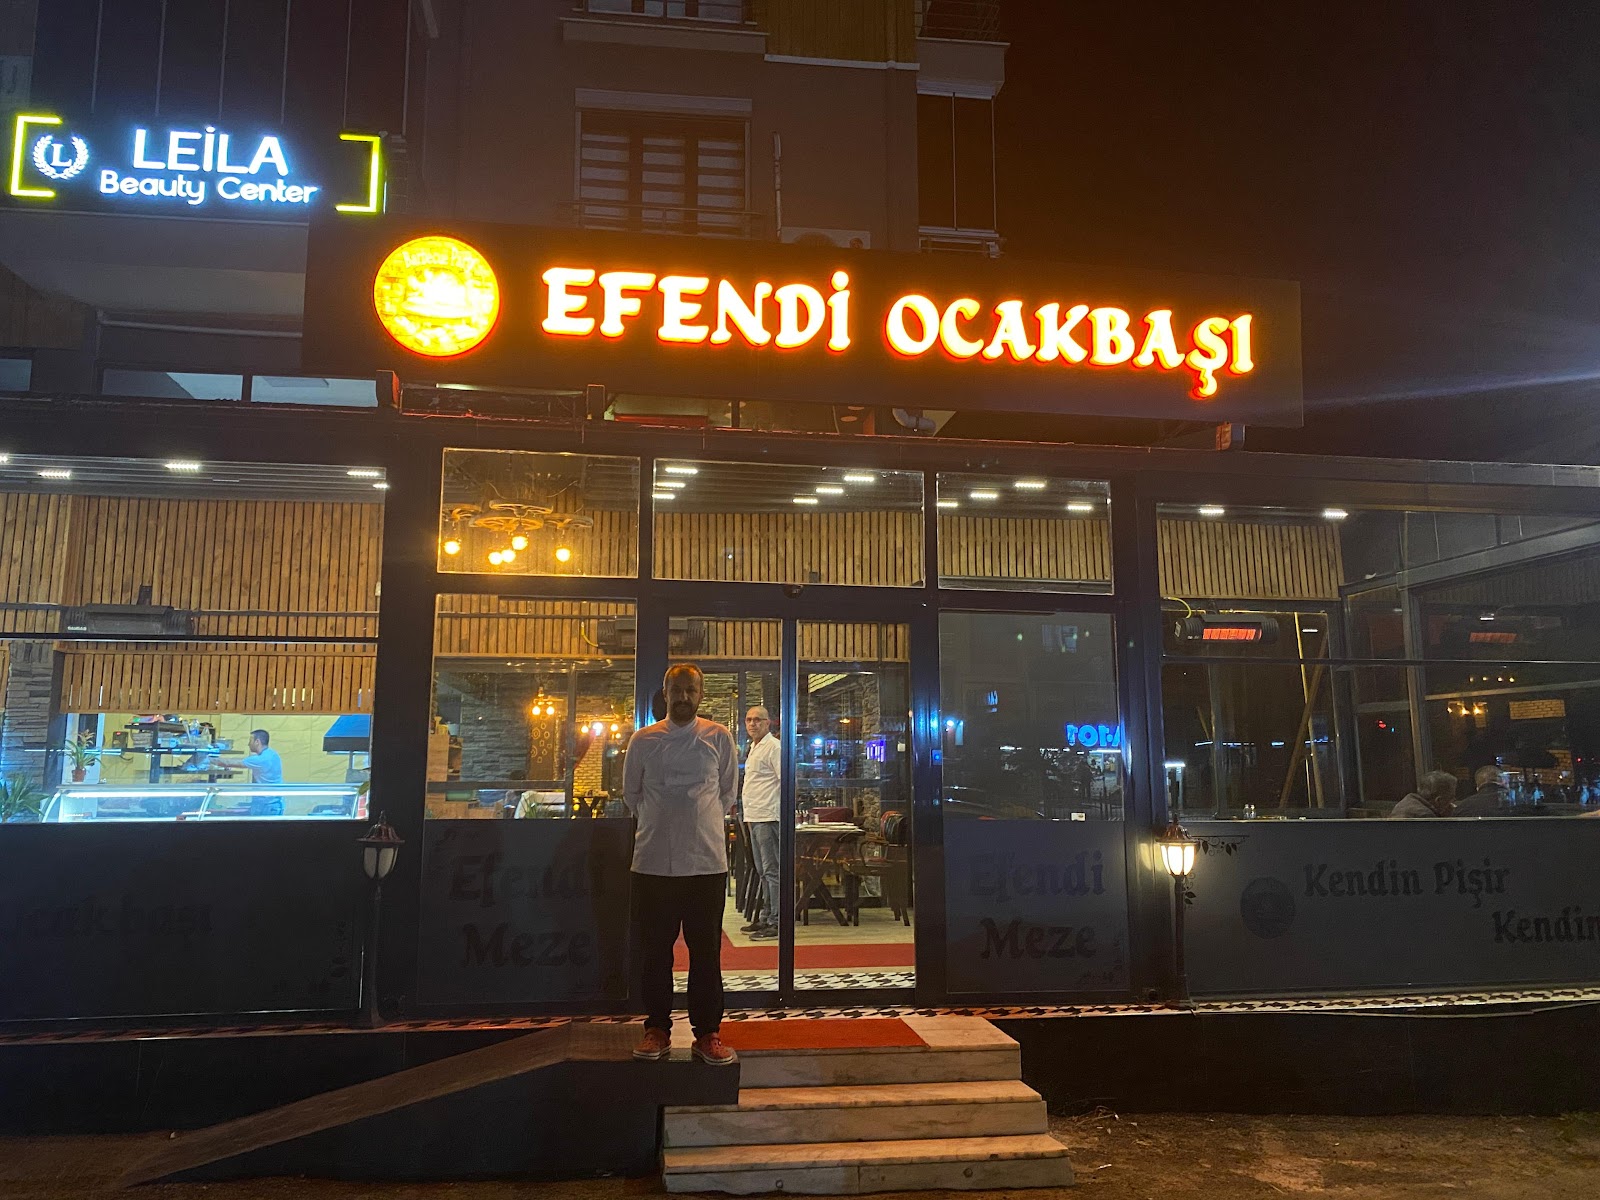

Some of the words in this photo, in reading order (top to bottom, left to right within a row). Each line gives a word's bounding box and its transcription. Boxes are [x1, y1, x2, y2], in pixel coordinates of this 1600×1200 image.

[50, 143, 72, 167] L
[132, 126, 289, 176] LEİLA
[100, 169, 205, 206] Beauty
[217, 178, 317, 204] Center
[885, 294, 1255, 398] OCAKBAŞI
[970, 850, 1106, 904] Efendi
[1302, 858, 1424, 897] Kendin
[1433, 857, 1511, 910] Pişir
[459, 921, 592, 968] Meze
[980, 917, 1097, 960] Meze
[1491, 905, 1600, 944] Kendin
